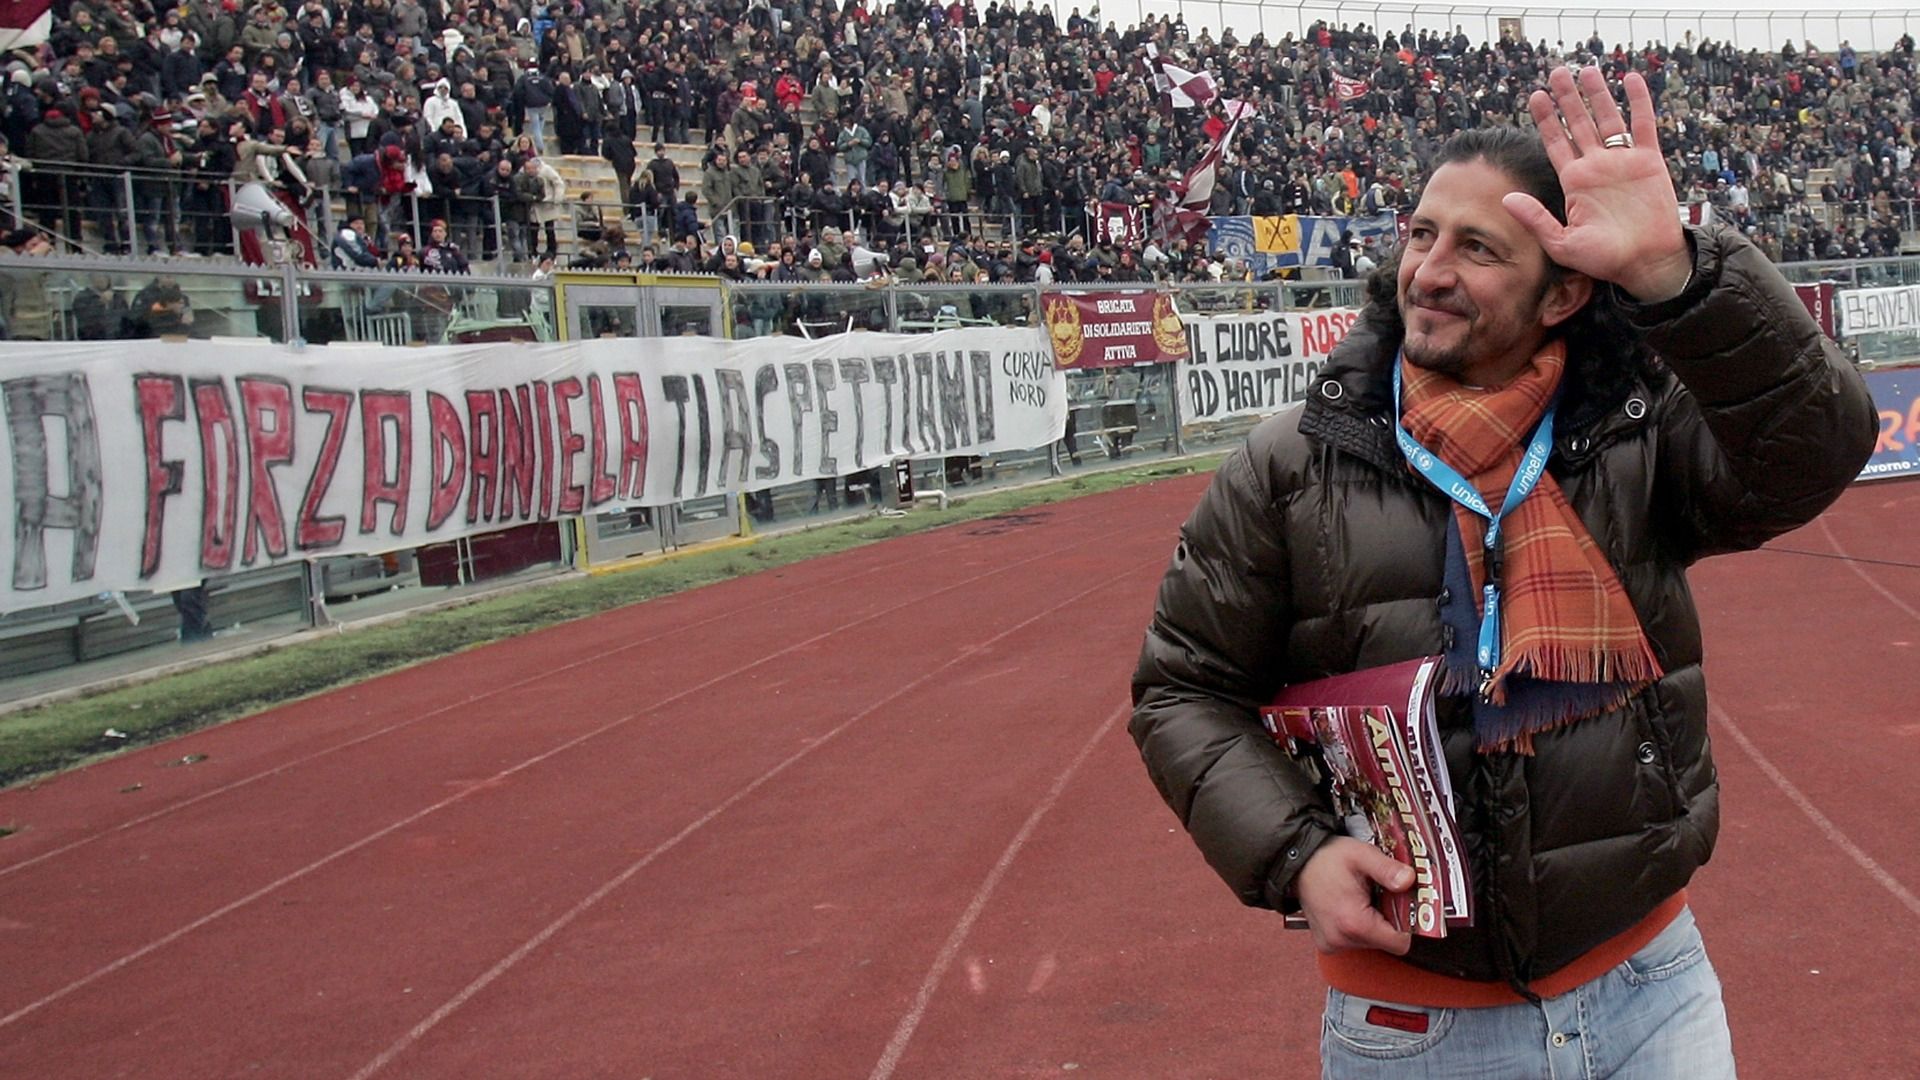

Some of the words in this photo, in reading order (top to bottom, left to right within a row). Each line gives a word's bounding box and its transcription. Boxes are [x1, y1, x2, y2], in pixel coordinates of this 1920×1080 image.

[1097, 300, 1136, 314] BRIGATA
[1083, 324, 1093, 338] DI
[1184, 323, 1207, 365] IL
[1215, 318, 1292, 363] CUORE
[1003, 351, 1055, 380] CURVA
[1104, 344, 1137, 360] ATTIVA
[1010, 380, 1046, 408] NORD
[1188, 369, 1219, 417] AD
[1221, 363, 1289, 412] HAITI
[133, 371, 411, 579] FORZA
[425, 371, 649, 531] DANIELA
[661, 373, 711, 498] TI
[714, 350, 995, 488] ASPETTIAMO
[1517, 452, 1543, 496] unicef
[1451, 482, 1493, 517] unice
[1366, 714, 1439, 932] Amaranto
